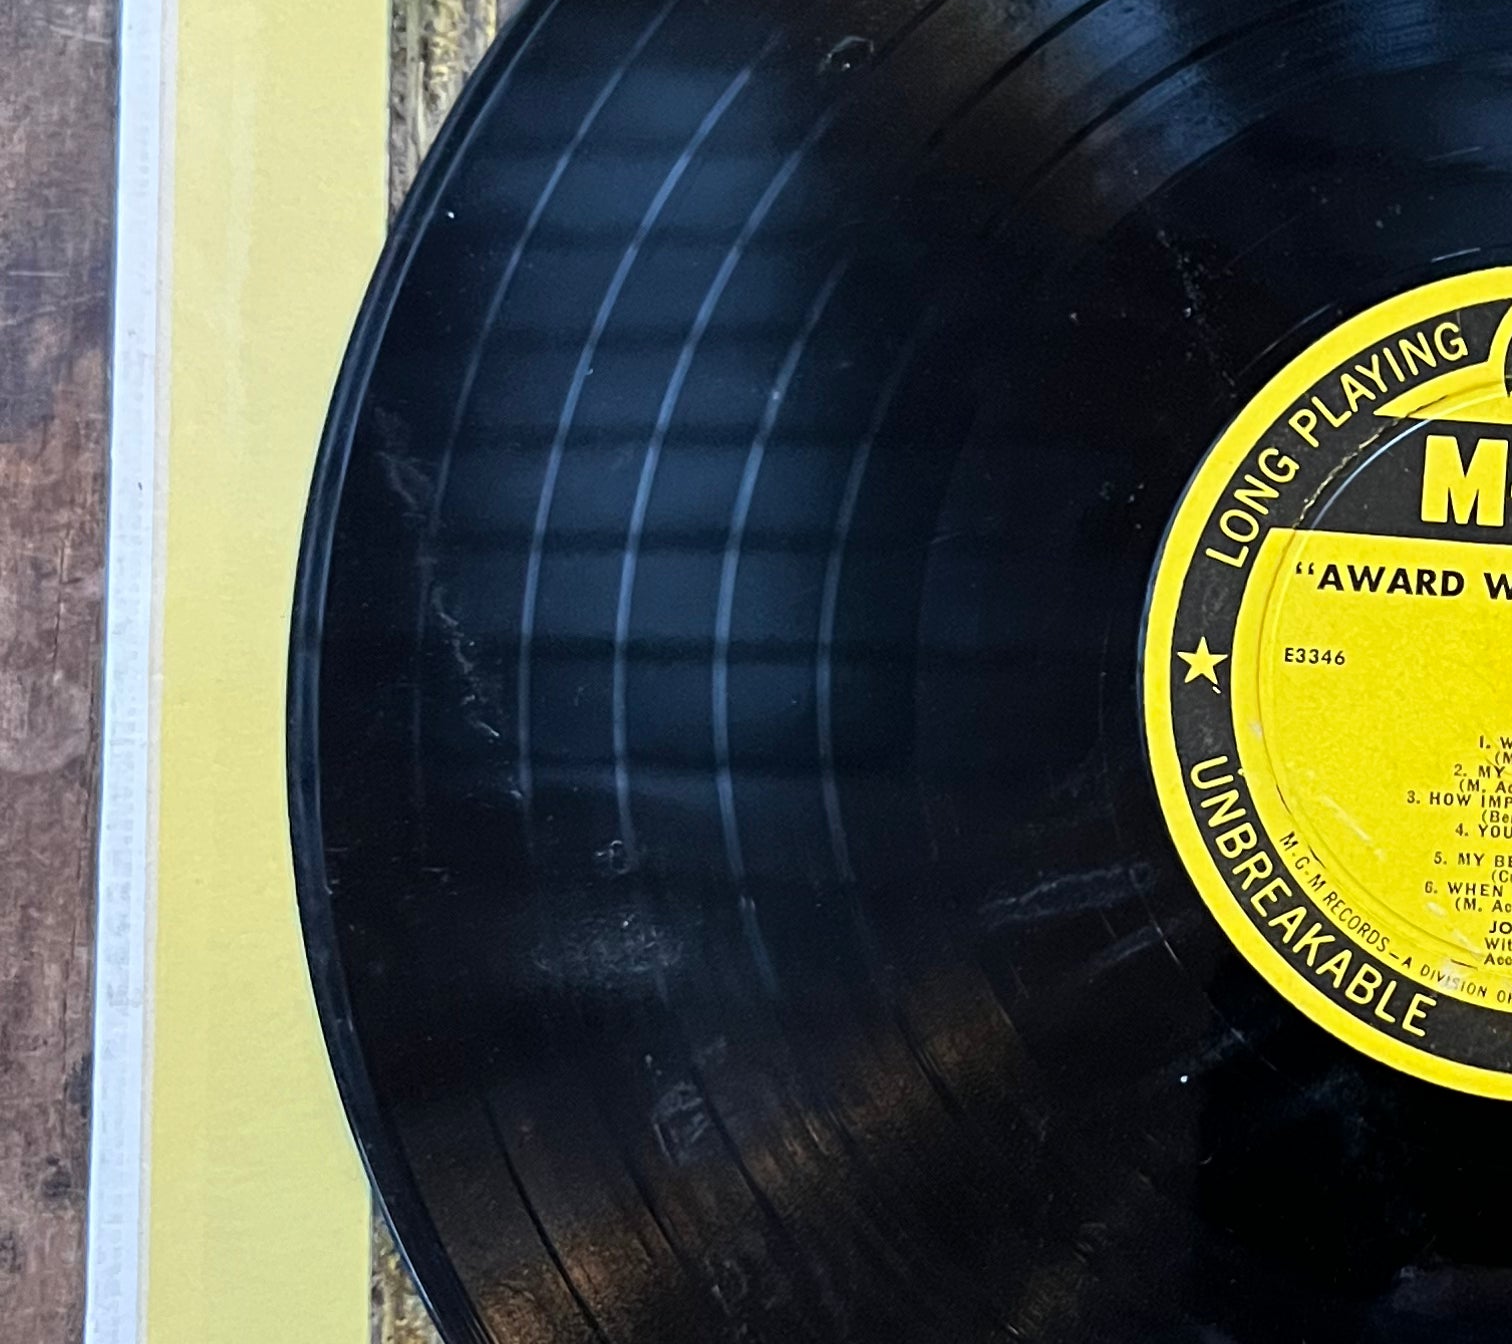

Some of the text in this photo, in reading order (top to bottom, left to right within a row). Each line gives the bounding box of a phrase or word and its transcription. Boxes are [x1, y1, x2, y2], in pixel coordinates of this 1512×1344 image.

[1205, 321, 1469, 568] LONG PLAYING
[1284, 647, 1346, 666] E3346
[1453, 763, 1467, 777] 2.
[1478, 765, 1505, 779] MY
[1459, 778, 1487, 793] (M.
[1406, 790, 1421, 804] 3.
[1429, 791, 1472, 807] HOW
[1455, 822, 1469, 837] 4.
[1434, 850, 1448, 865] 5.
[1458, 852, 1485, 866] MY
[1190, 755, 1438, 1038] UNBREAKABLE
[1424, 880, 1438, 894] 6.
[1448, 881, 1504, 898] WHEN
[1455, 897, 1483, 912] (M.
[1420, 964, 1488, 999] DIVISION
